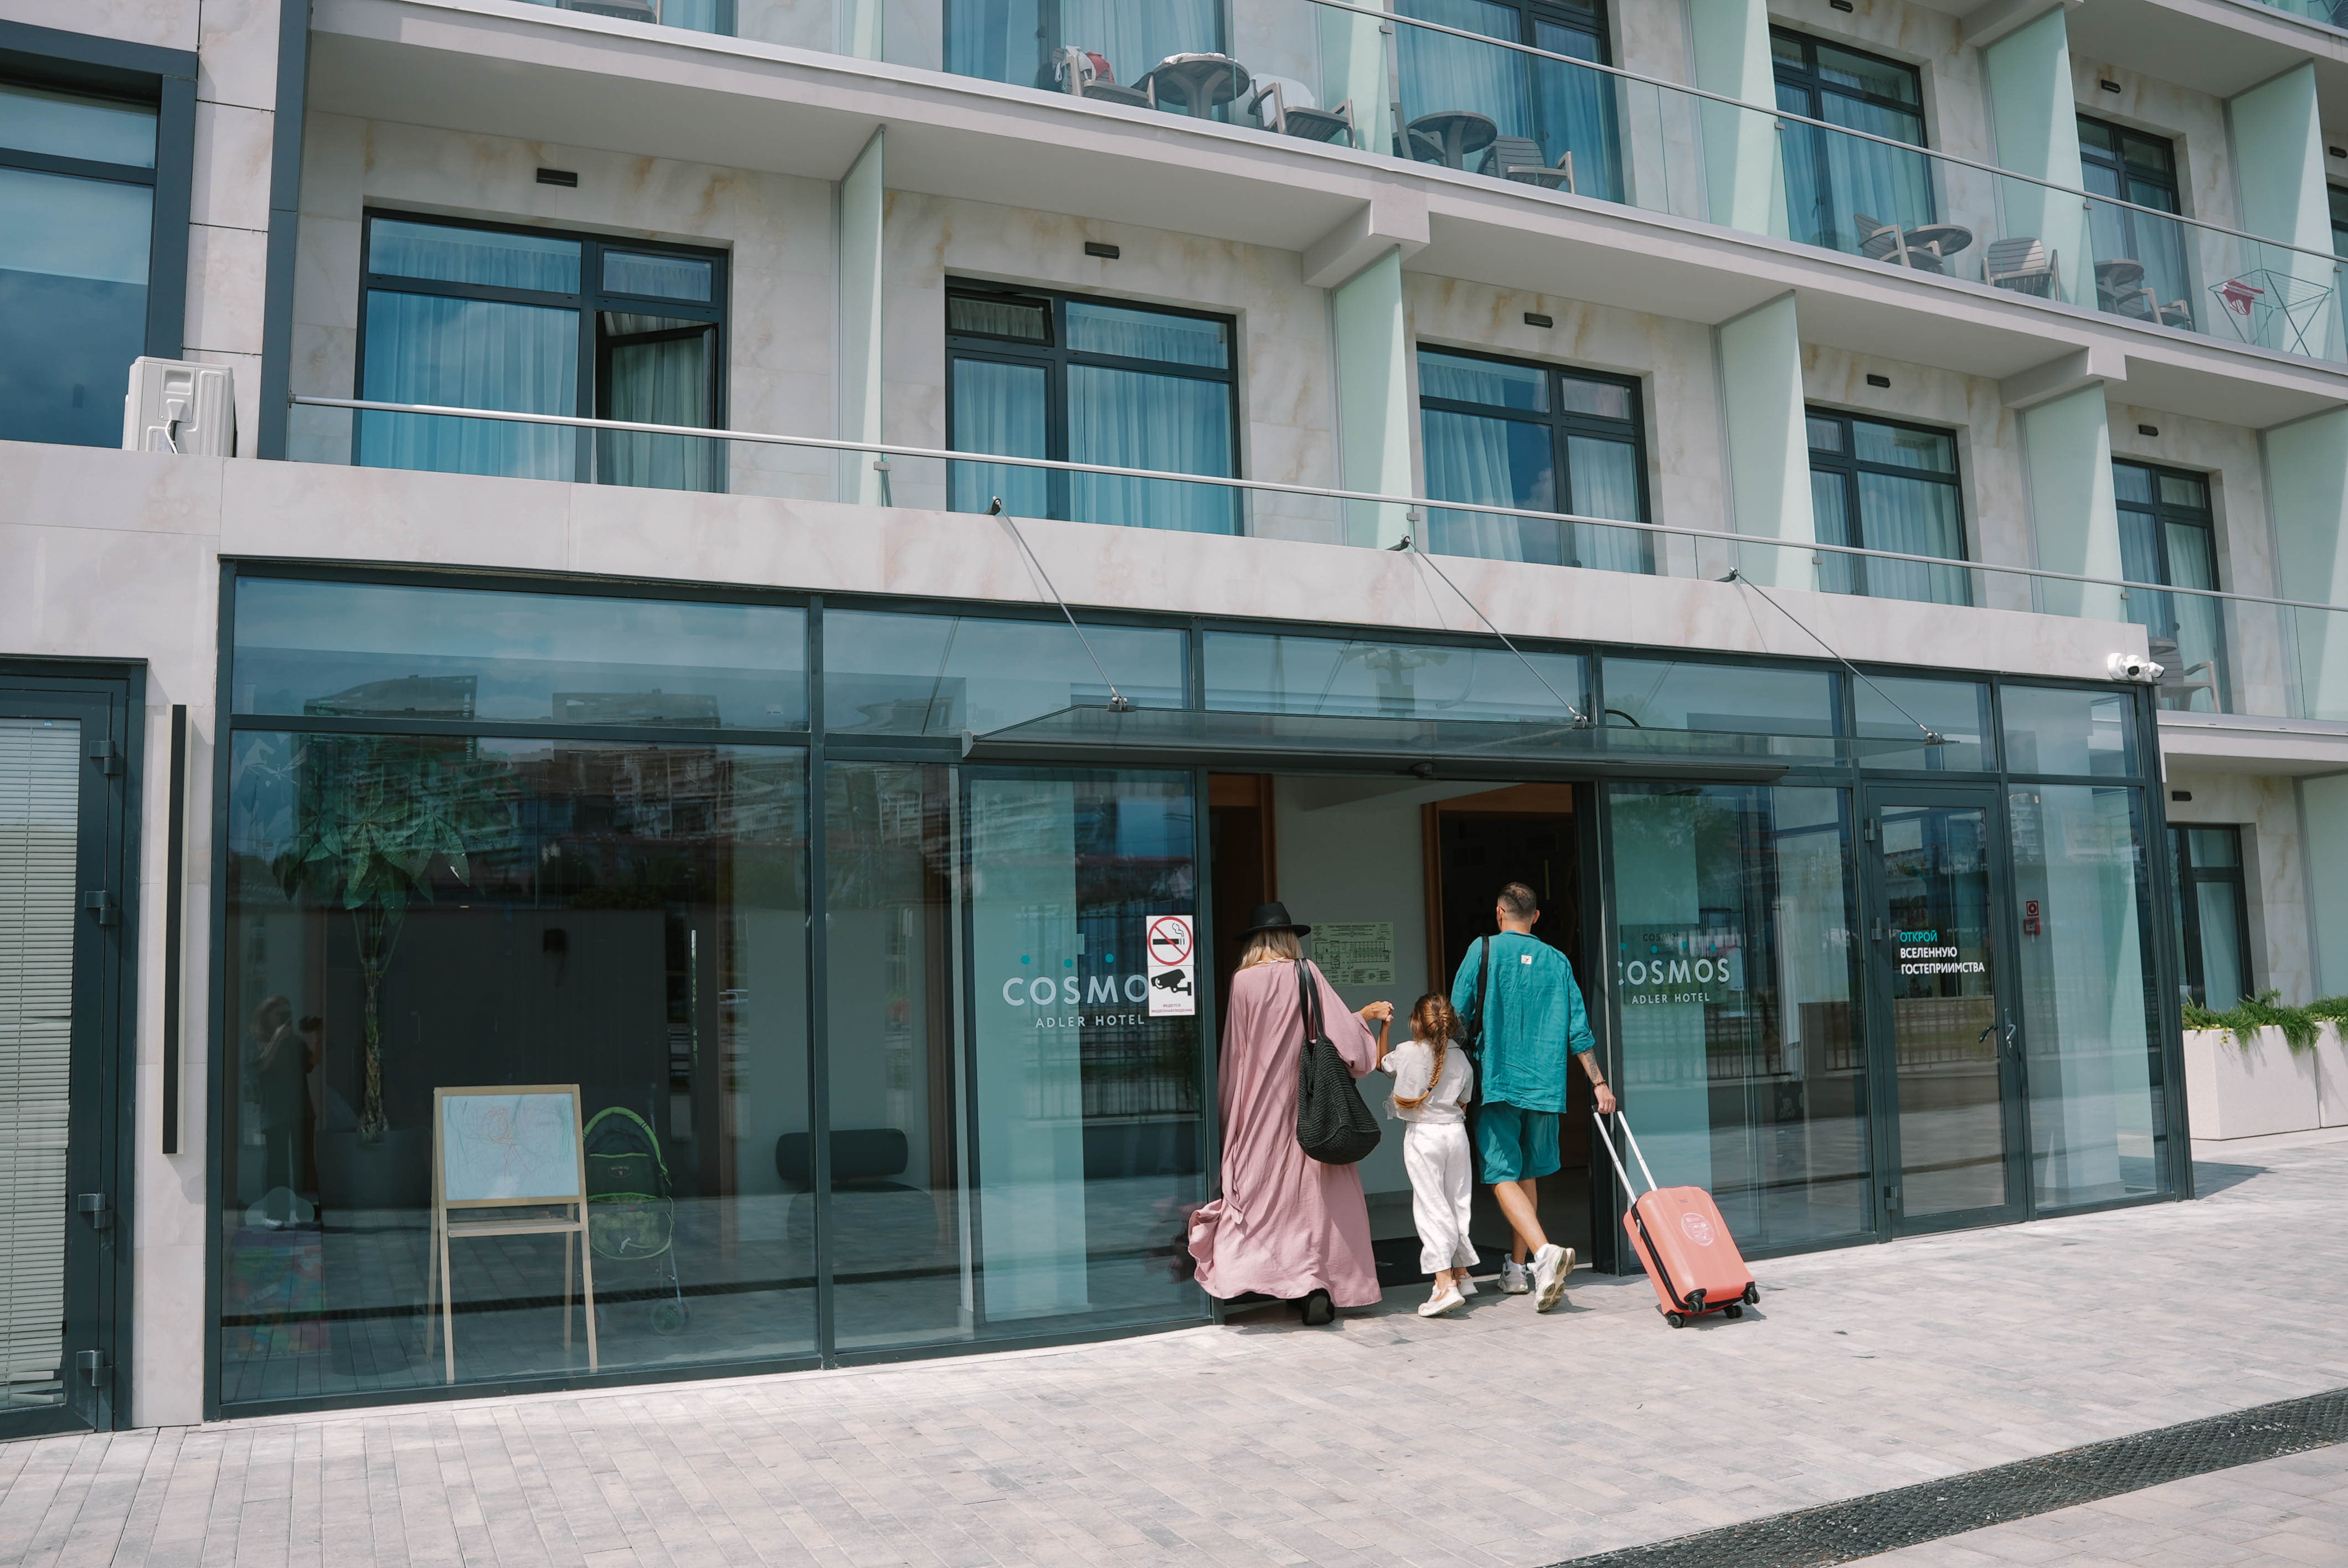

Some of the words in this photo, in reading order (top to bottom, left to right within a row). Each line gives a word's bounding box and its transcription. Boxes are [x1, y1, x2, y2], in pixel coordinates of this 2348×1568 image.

[1900, 931, 1937, 942] ОТКРОЙ
[1900, 947, 1958, 958] ВСЕЛЕННУЮ
[1901, 962, 1985, 974] ГОСТЕПРИИМСТВА
[1003, 974, 1149, 1005] COSMO
[1631, 995, 1668, 1005] ADLER
[1675, 993, 1710, 1003] HOTEL
[1036, 1016, 1085, 1028] ADLER
[1095, 1014, 1144, 1027] HOTEL
